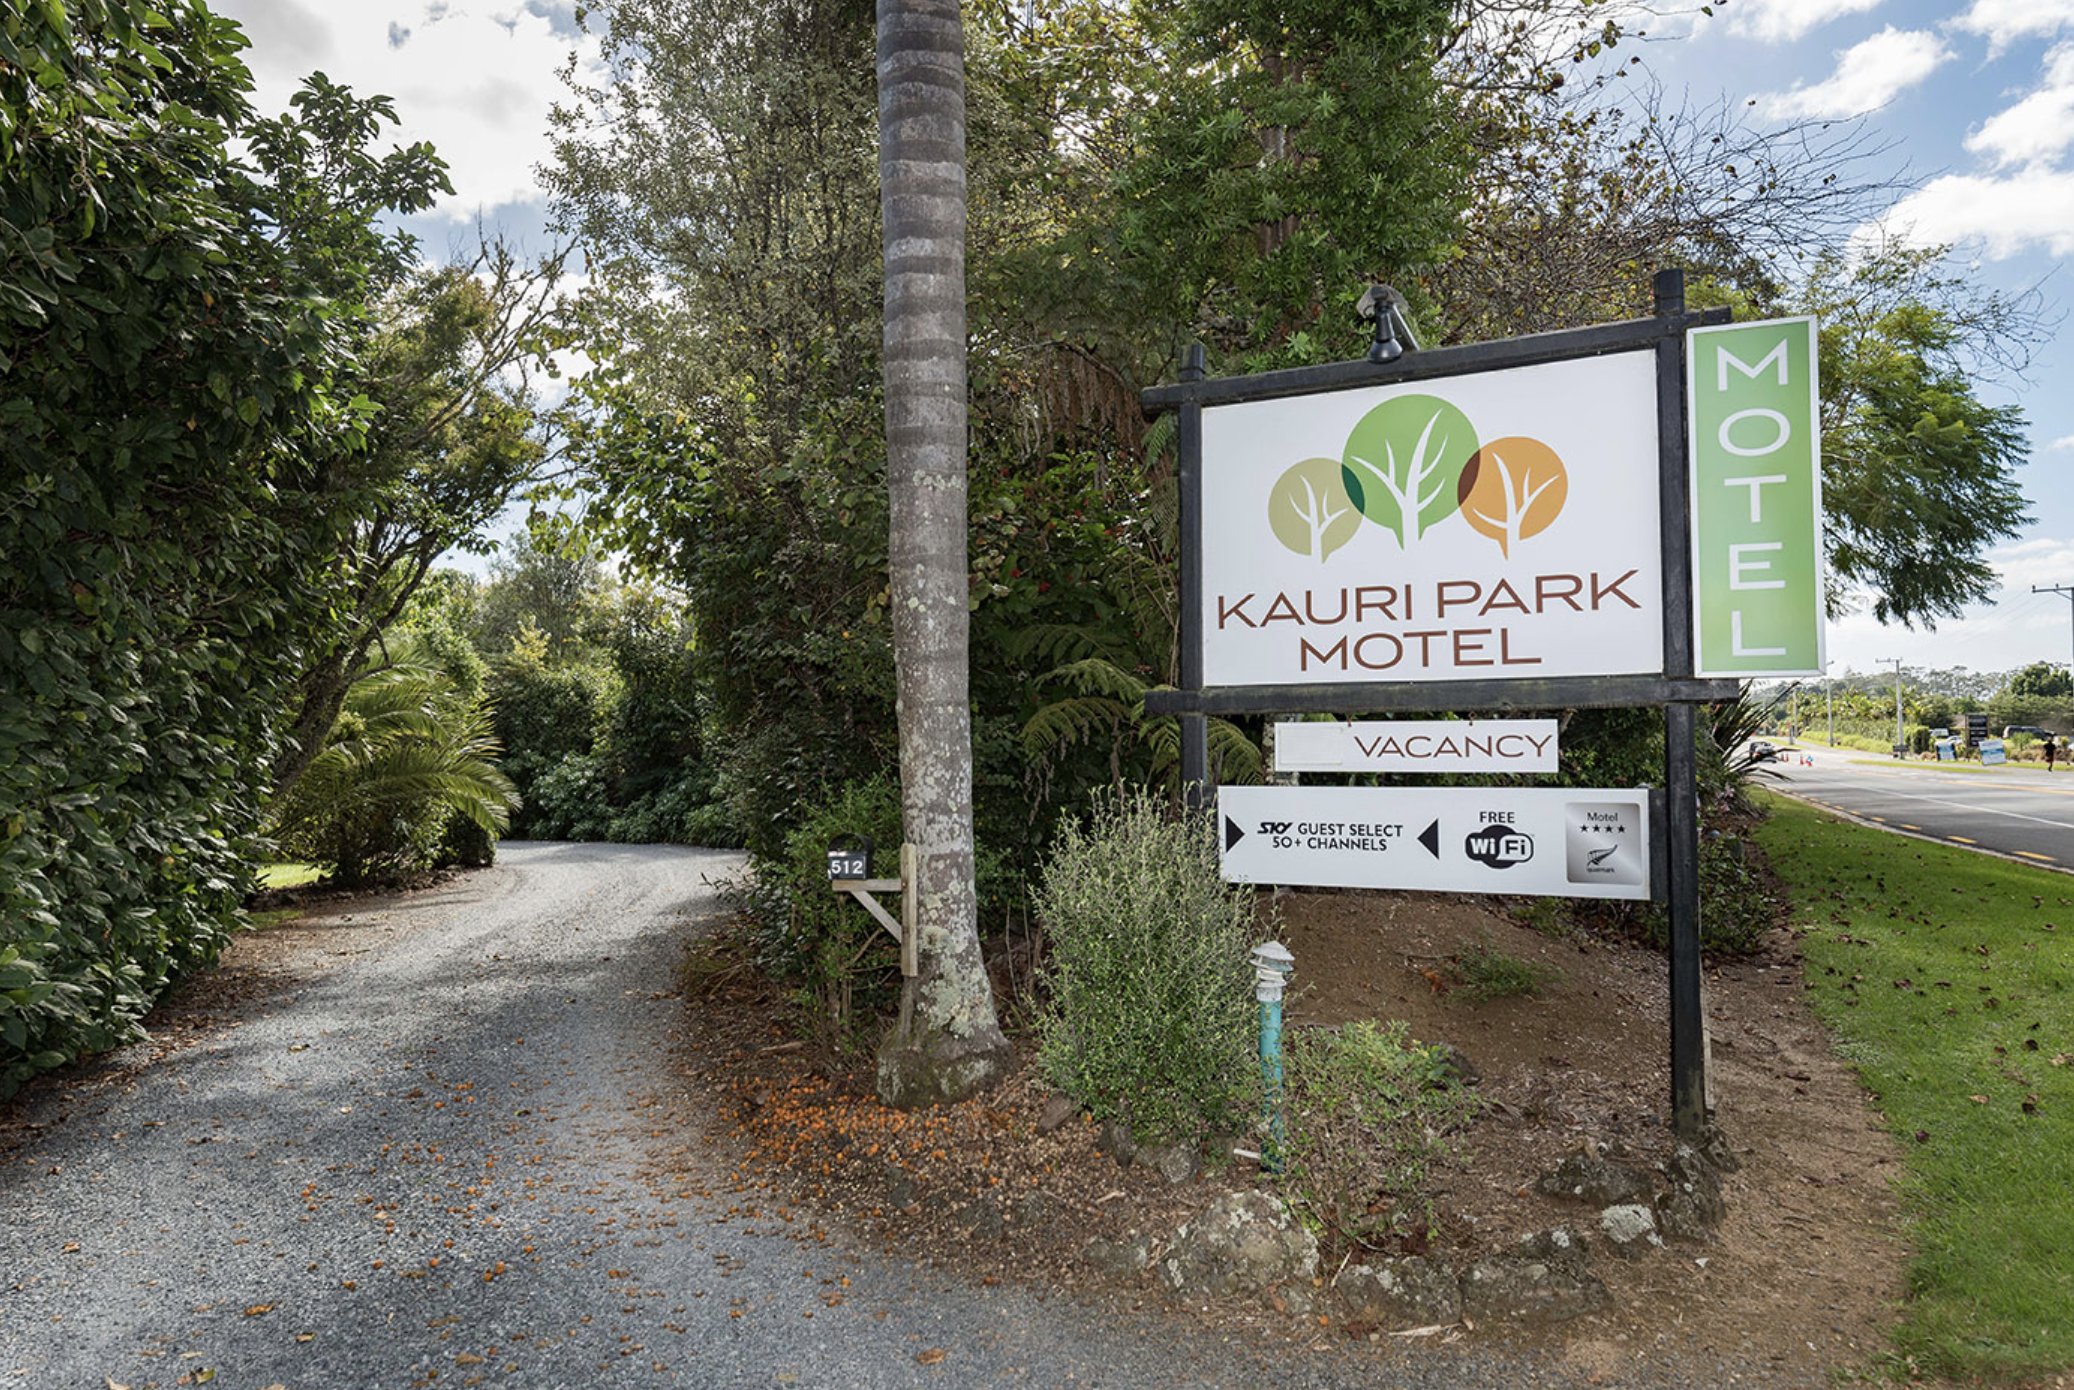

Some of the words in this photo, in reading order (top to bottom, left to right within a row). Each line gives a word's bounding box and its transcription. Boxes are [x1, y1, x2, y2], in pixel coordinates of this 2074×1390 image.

[1717, 337, 1791, 657] MOTEL
[1217, 583, 1413, 630] KAURI
[1437, 569, 1642, 619] PARK
[1300, 627, 1543, 672] MOTEL
[1353, 734, 1553, 759] VACANCY
[1480, 811, 1515, 824] FREE
[1587, 812, 1618, 822] Motel
[1257, 822, 1293, 834] SKY
[1297, 822, 1345, 835] GUEST
[1349, 823, 1404, 837] SELECT
[1306, 837, 1388, 851] CHANNELS
[831, 860, 863, 875] 512
